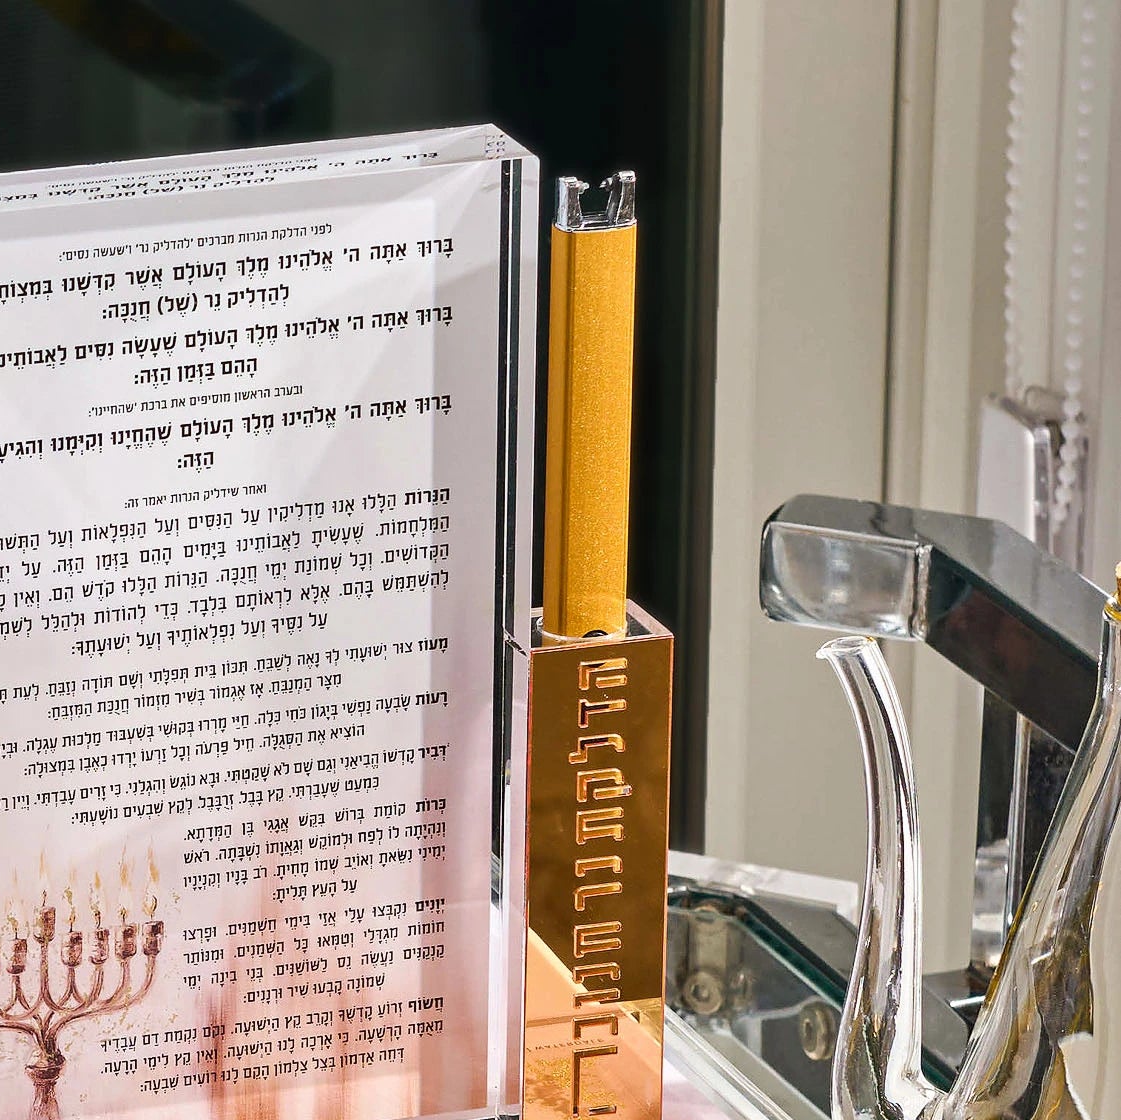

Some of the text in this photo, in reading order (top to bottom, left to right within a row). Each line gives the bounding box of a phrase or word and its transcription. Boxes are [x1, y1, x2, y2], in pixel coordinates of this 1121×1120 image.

[568, 656, 633, 1119] הדלקת נר חנוכה
